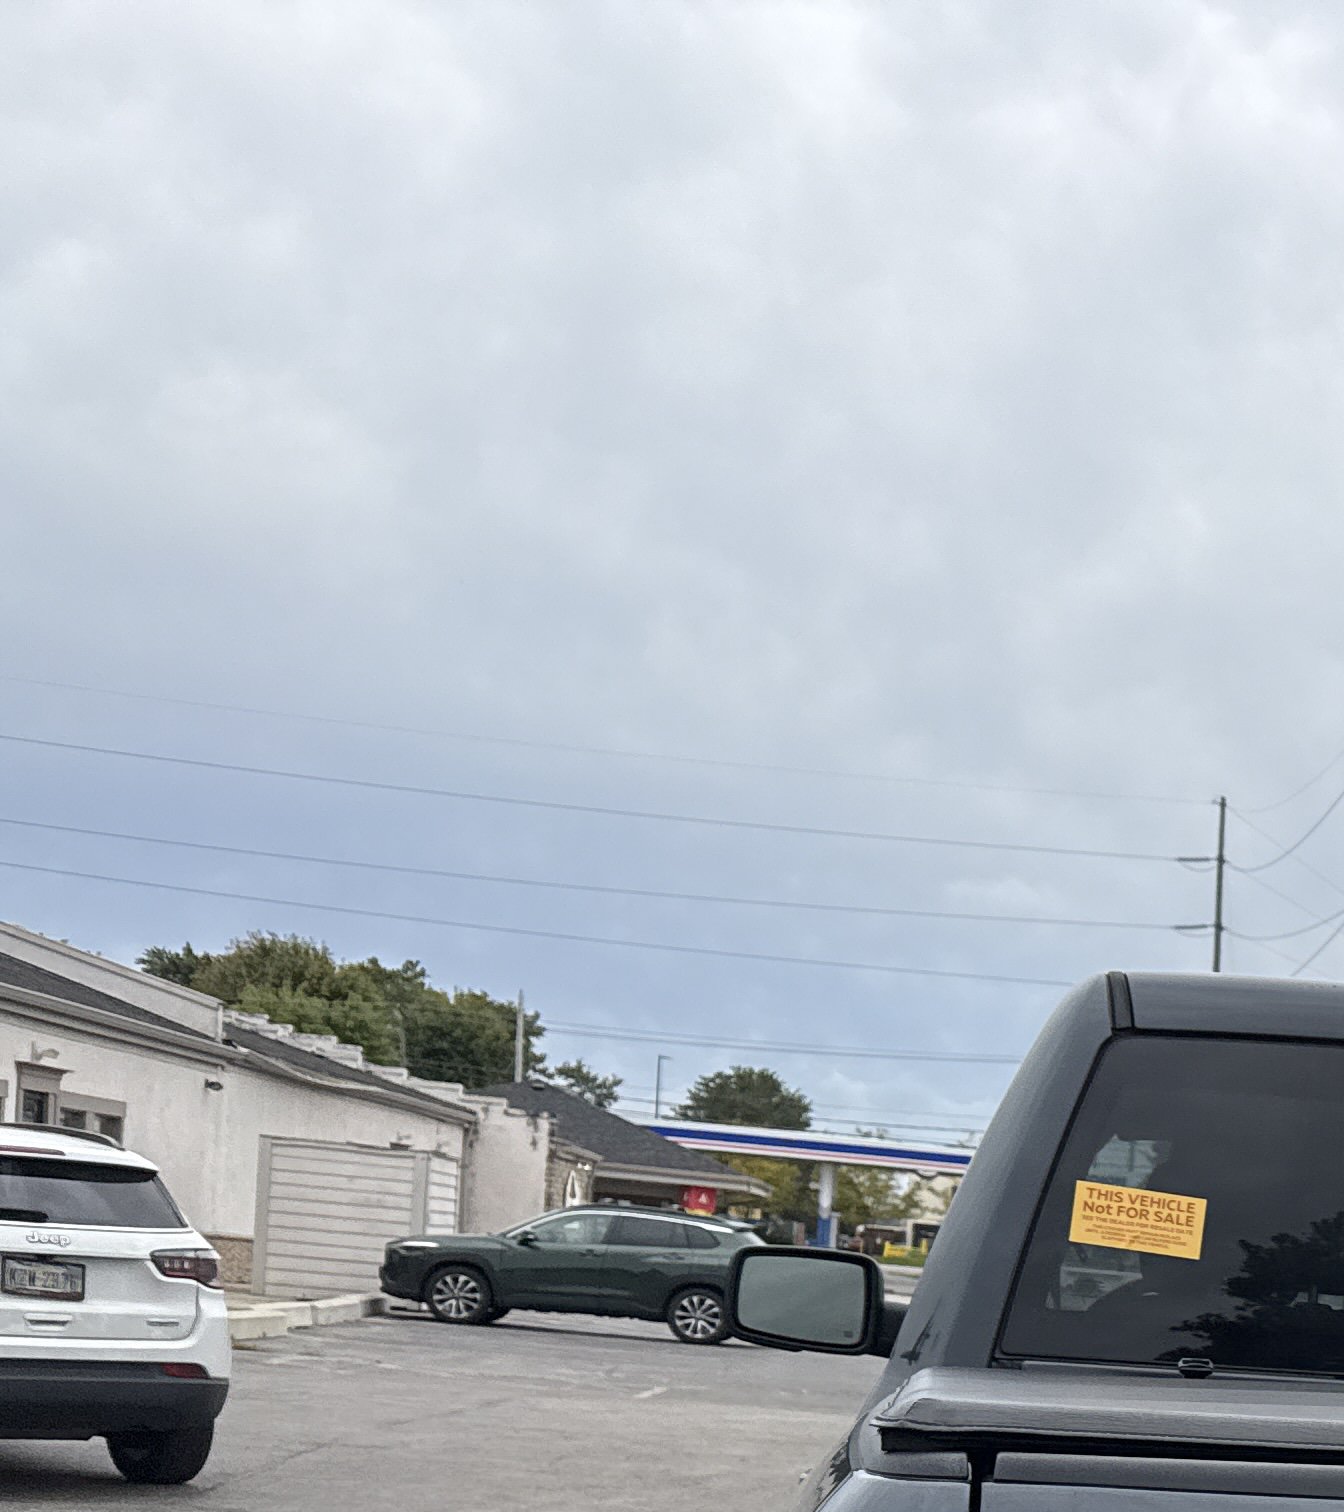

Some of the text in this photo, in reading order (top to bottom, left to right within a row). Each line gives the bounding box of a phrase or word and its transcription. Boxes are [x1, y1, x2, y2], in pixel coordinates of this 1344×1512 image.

[1086, 1187, 1196, 1214] THIS VEHICLE
[1082, 1200, 1195, 1228] Not FOR SALE
[1110, 1218, 1135, 1226] DEALER
[26, 1231, 71, 1248] Jeep
